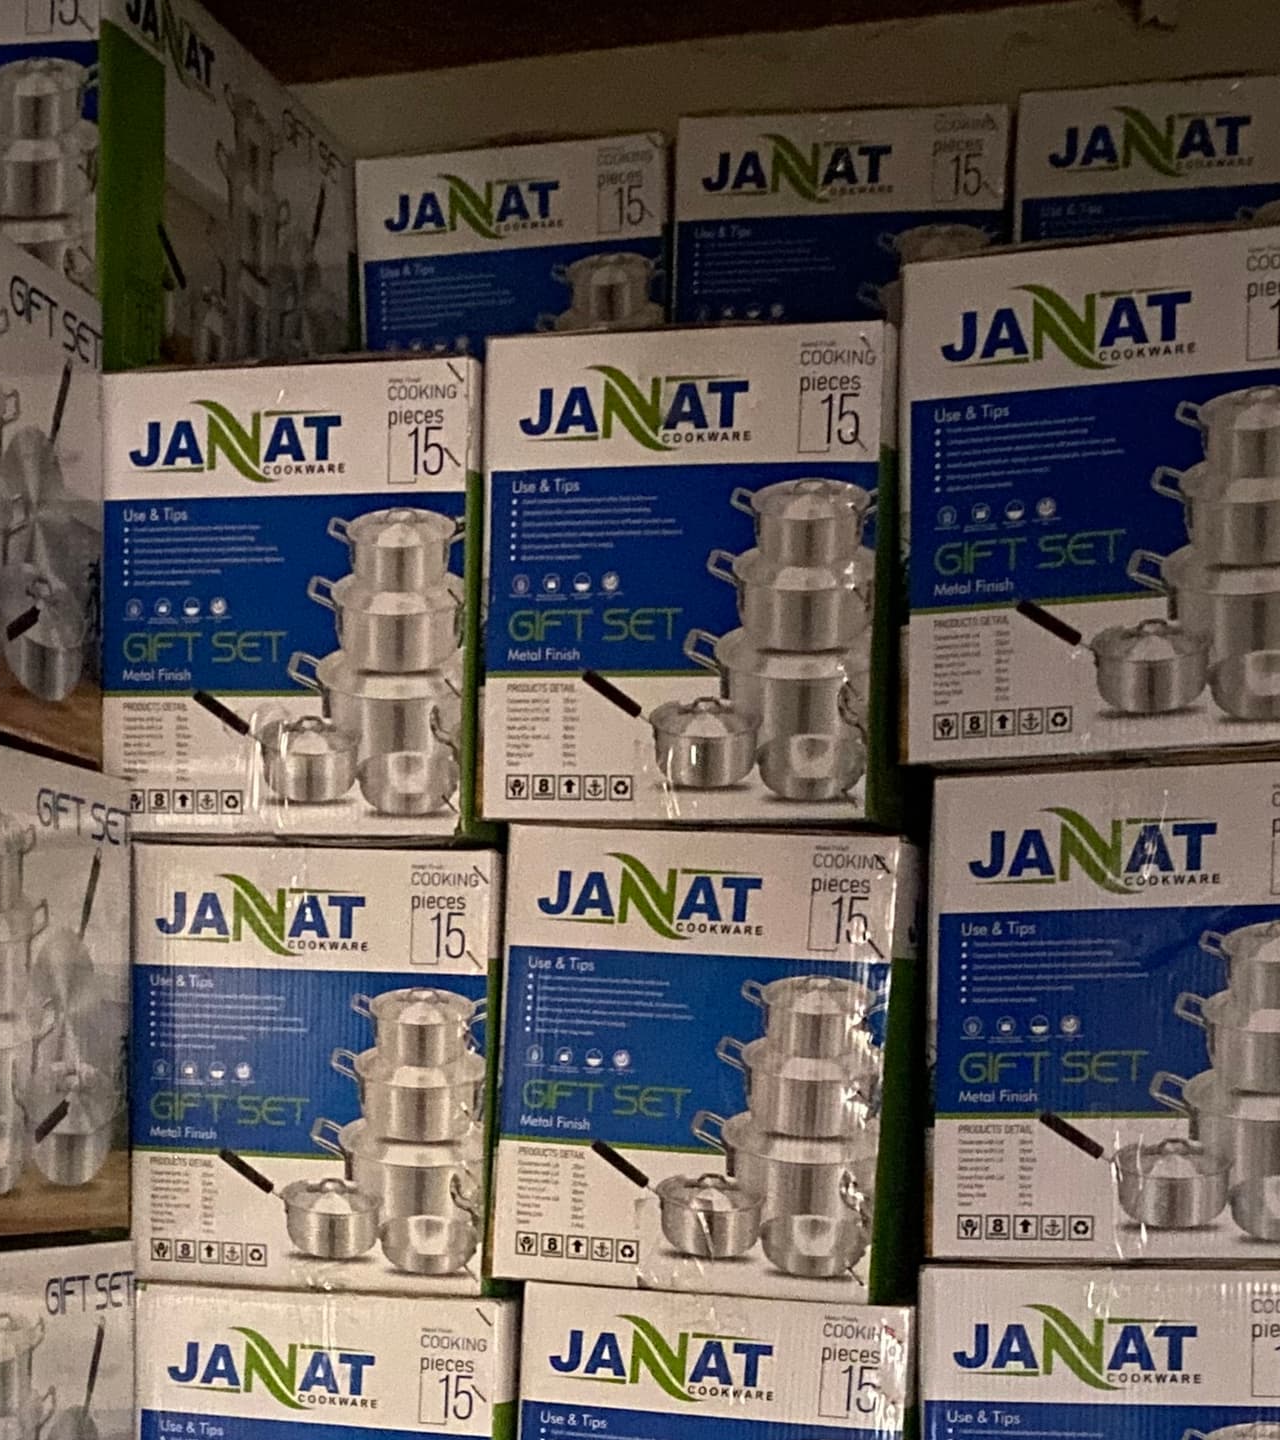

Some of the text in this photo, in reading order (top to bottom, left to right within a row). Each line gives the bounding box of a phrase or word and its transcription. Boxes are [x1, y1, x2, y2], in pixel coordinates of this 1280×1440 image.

[1047, 107, 1253, 176] JANAT
[699, 133, 893, 202] JANAT
[383, 174, 560, 239] JANAT
[614, 185, 644, 227] 15
[942, 285, 1192, 369] JANAT
[387, 383, 457, 401] COOKING
[388, 407, 443, 427] pieces
[519, 365, 749, 451] JANAT
[818, 391, 859, 444] 15
[130, 400, 342, 482] JANAT
[407, 426, 444, 476] 15
[662, 431, 752, 445] COOKWARE
[263, 463, 346, 477] COOKWARE
[969, 808, 1217, 894] JANAT
[536, 851, 762, 939] JANAT
[1124, 873, 1221, 888] COOKWARE
[156, 873, 365, 956] JANAT
[429, 912, 465, 958] 15
[45, 1271, 135, 1316] GIFT SET
[167, 1325, 375, 1409] JANAT
[420, 1333, 488, 1352] COOKING
[420, 1354, 474, 1375] pieces
[548, 1313, 773, 1401] JANAT
[953, 1303, 1197, 1389] JANAT
[298, 1394, 378, 1409] COOKWARE
[540, 1411, 608, 1431] Use & Tips
